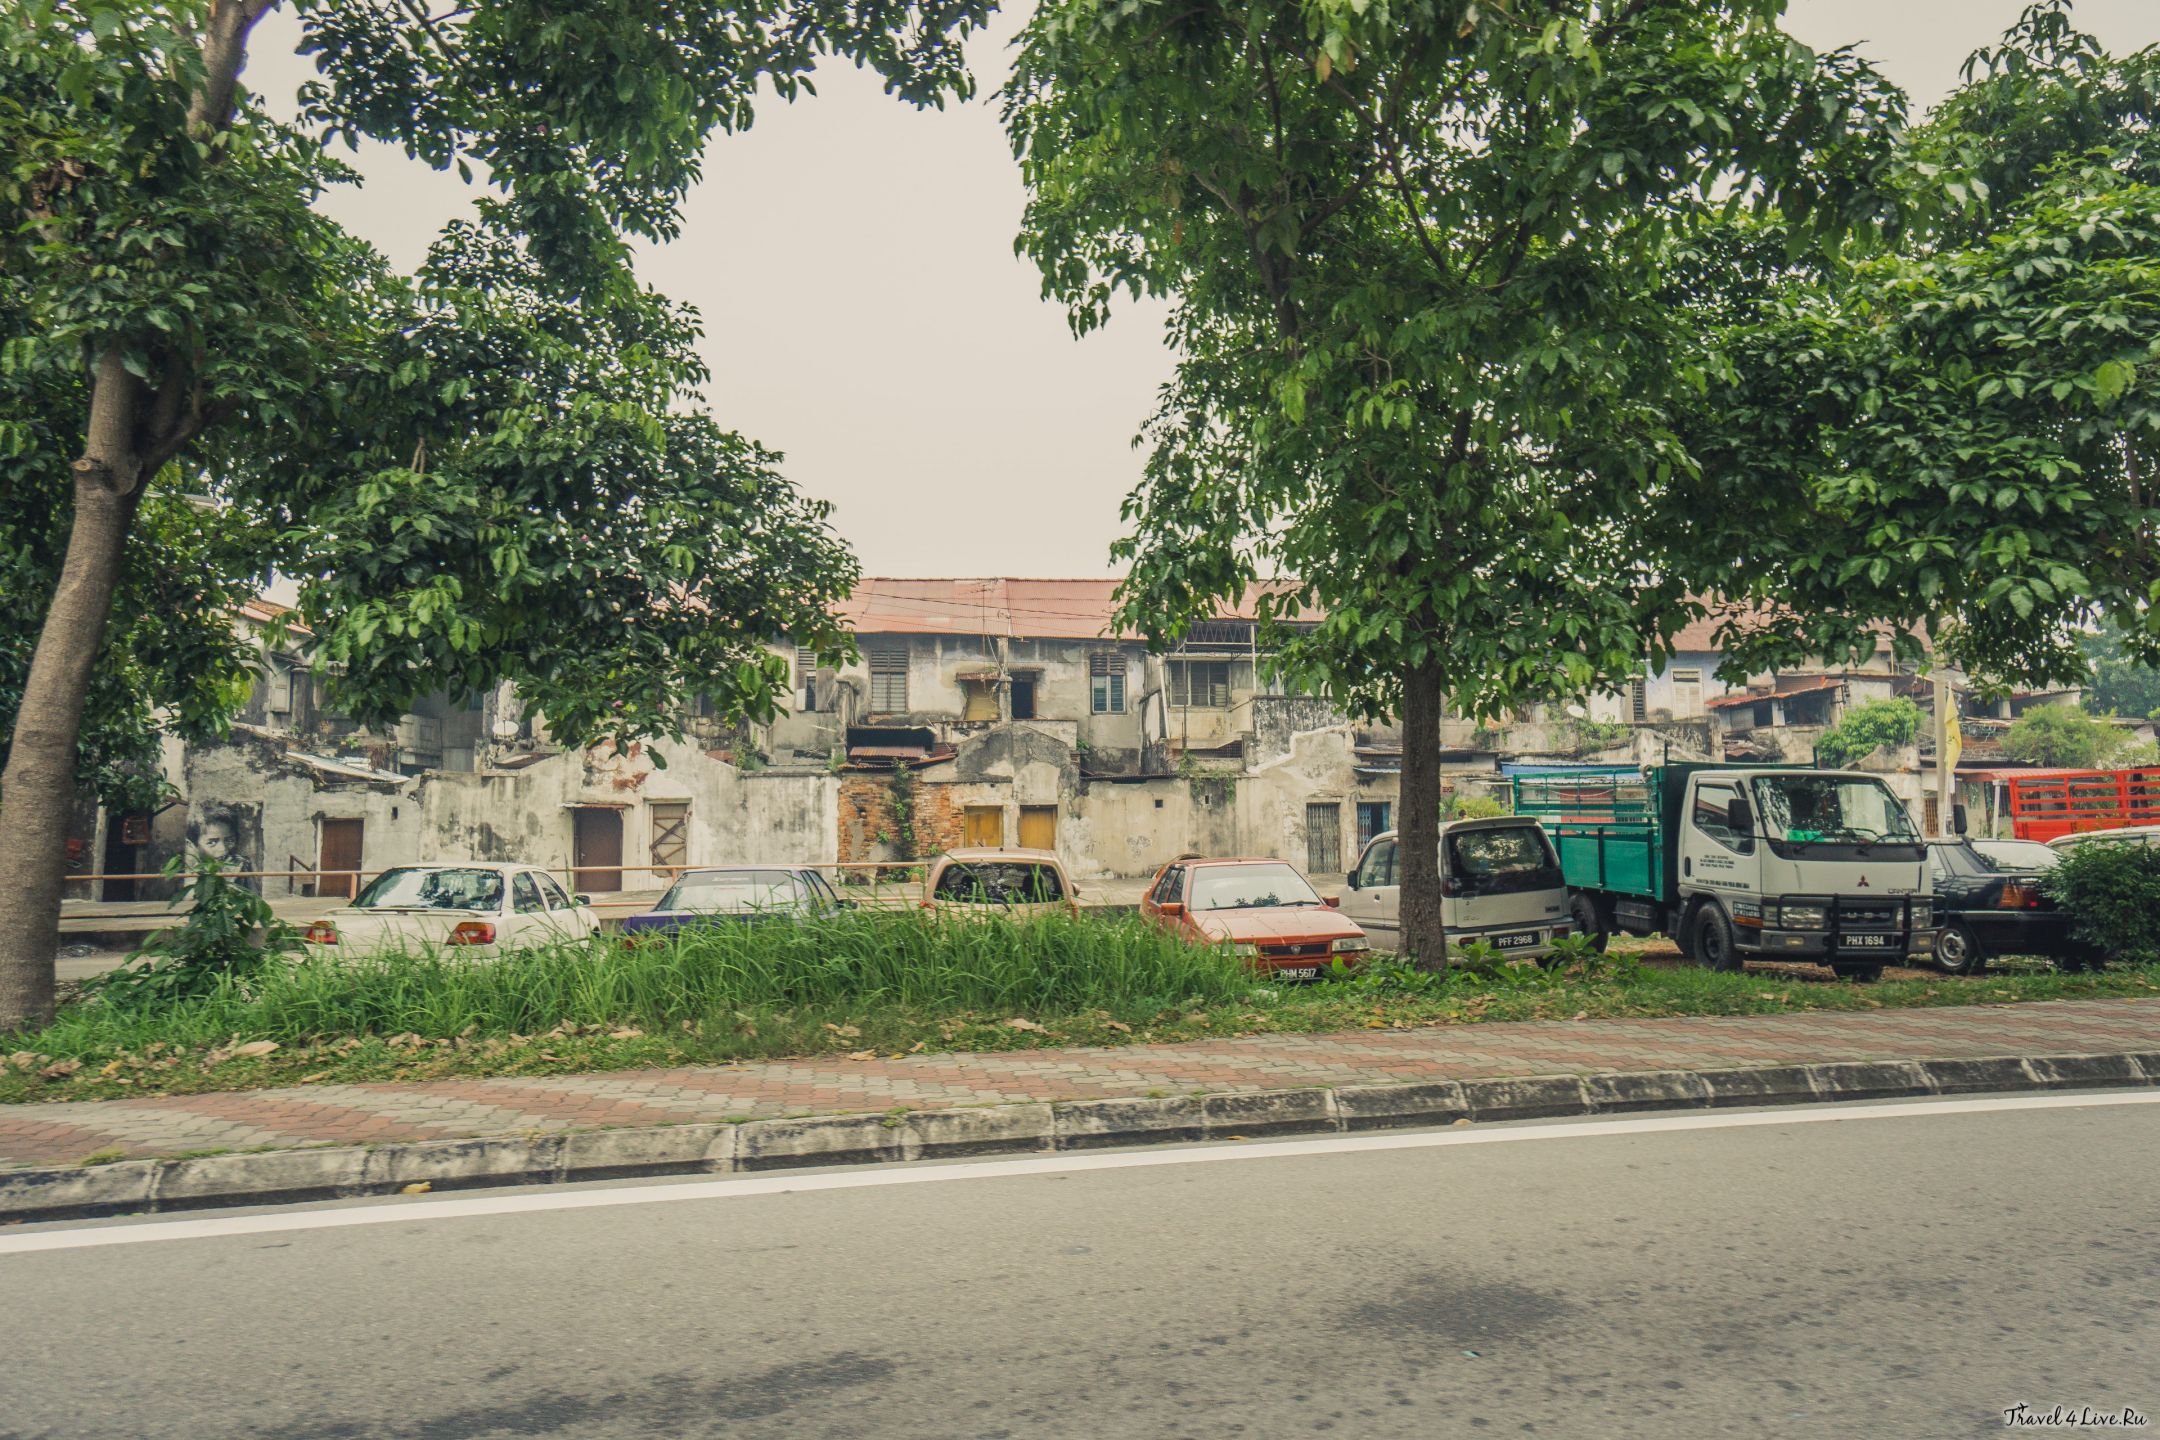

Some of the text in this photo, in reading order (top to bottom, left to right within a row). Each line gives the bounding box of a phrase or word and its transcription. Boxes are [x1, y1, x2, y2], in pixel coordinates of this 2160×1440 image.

[1498, 934, 1533, 947] PFF 2968
[1846, 935, 1885, 946] PHX 1694
[1280, 968, 1317, 979] PHM 5617
